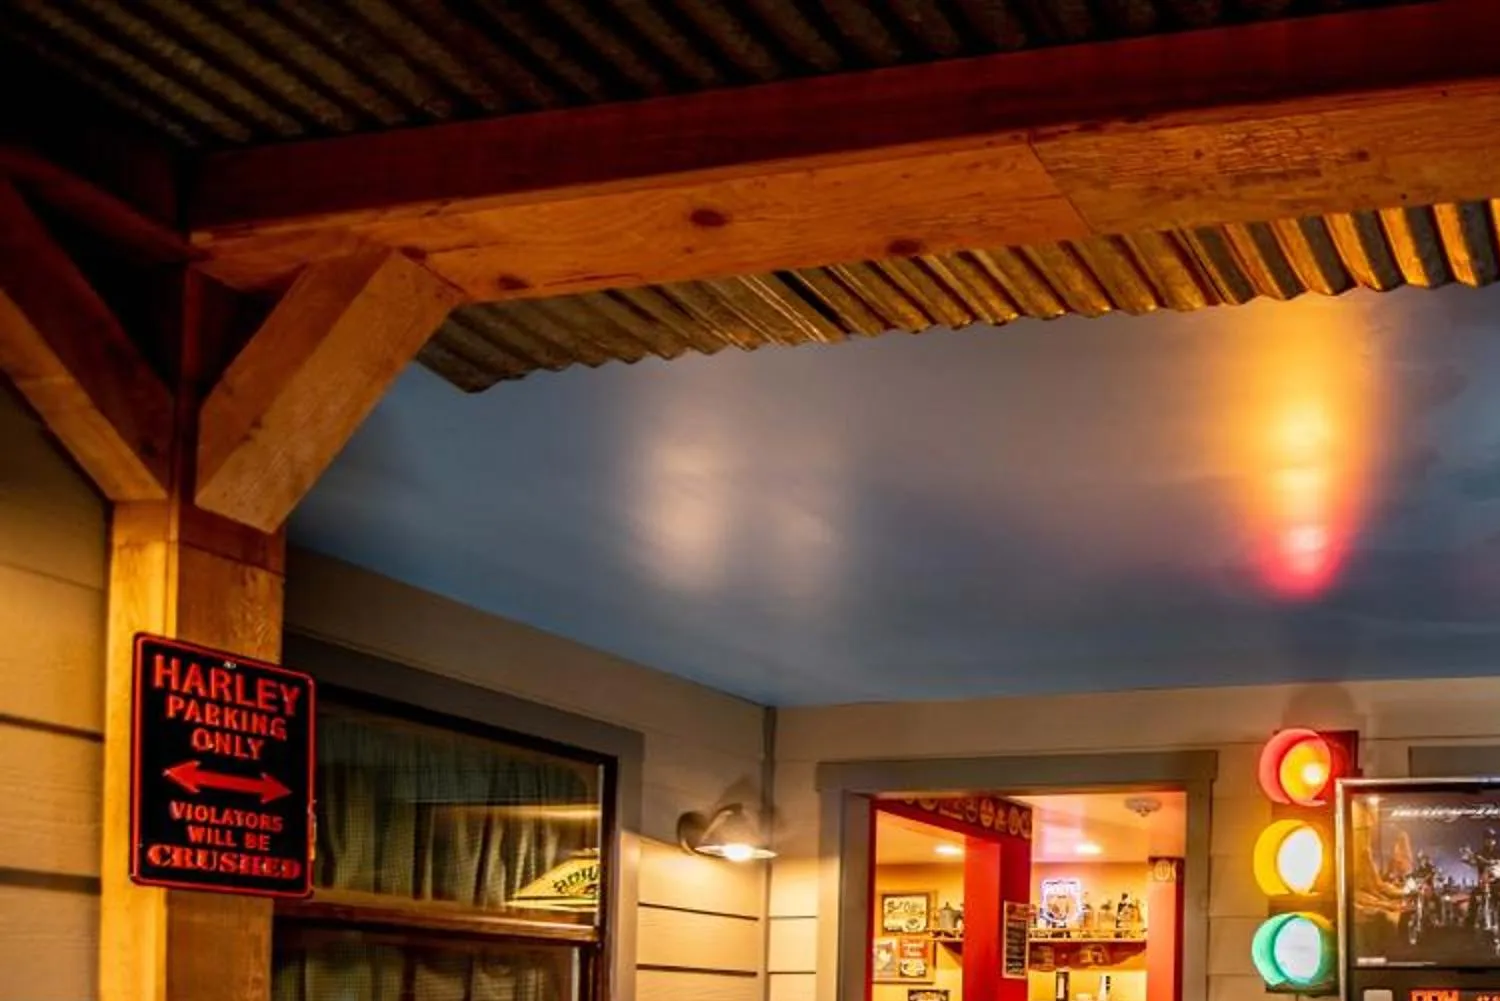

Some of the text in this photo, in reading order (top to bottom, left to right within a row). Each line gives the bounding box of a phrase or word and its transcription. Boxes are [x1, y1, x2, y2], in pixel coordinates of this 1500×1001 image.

[153, 654, 301, 715] HARLEY
[165, 695, 288, 740] PARKING
[191, 728, 264, 760] ONLY
[170, 800, 284, 832] VIOLATORS
[188, 825, 271, 851] WILL BE
[147, 844, 302, 879] CRUSHED
